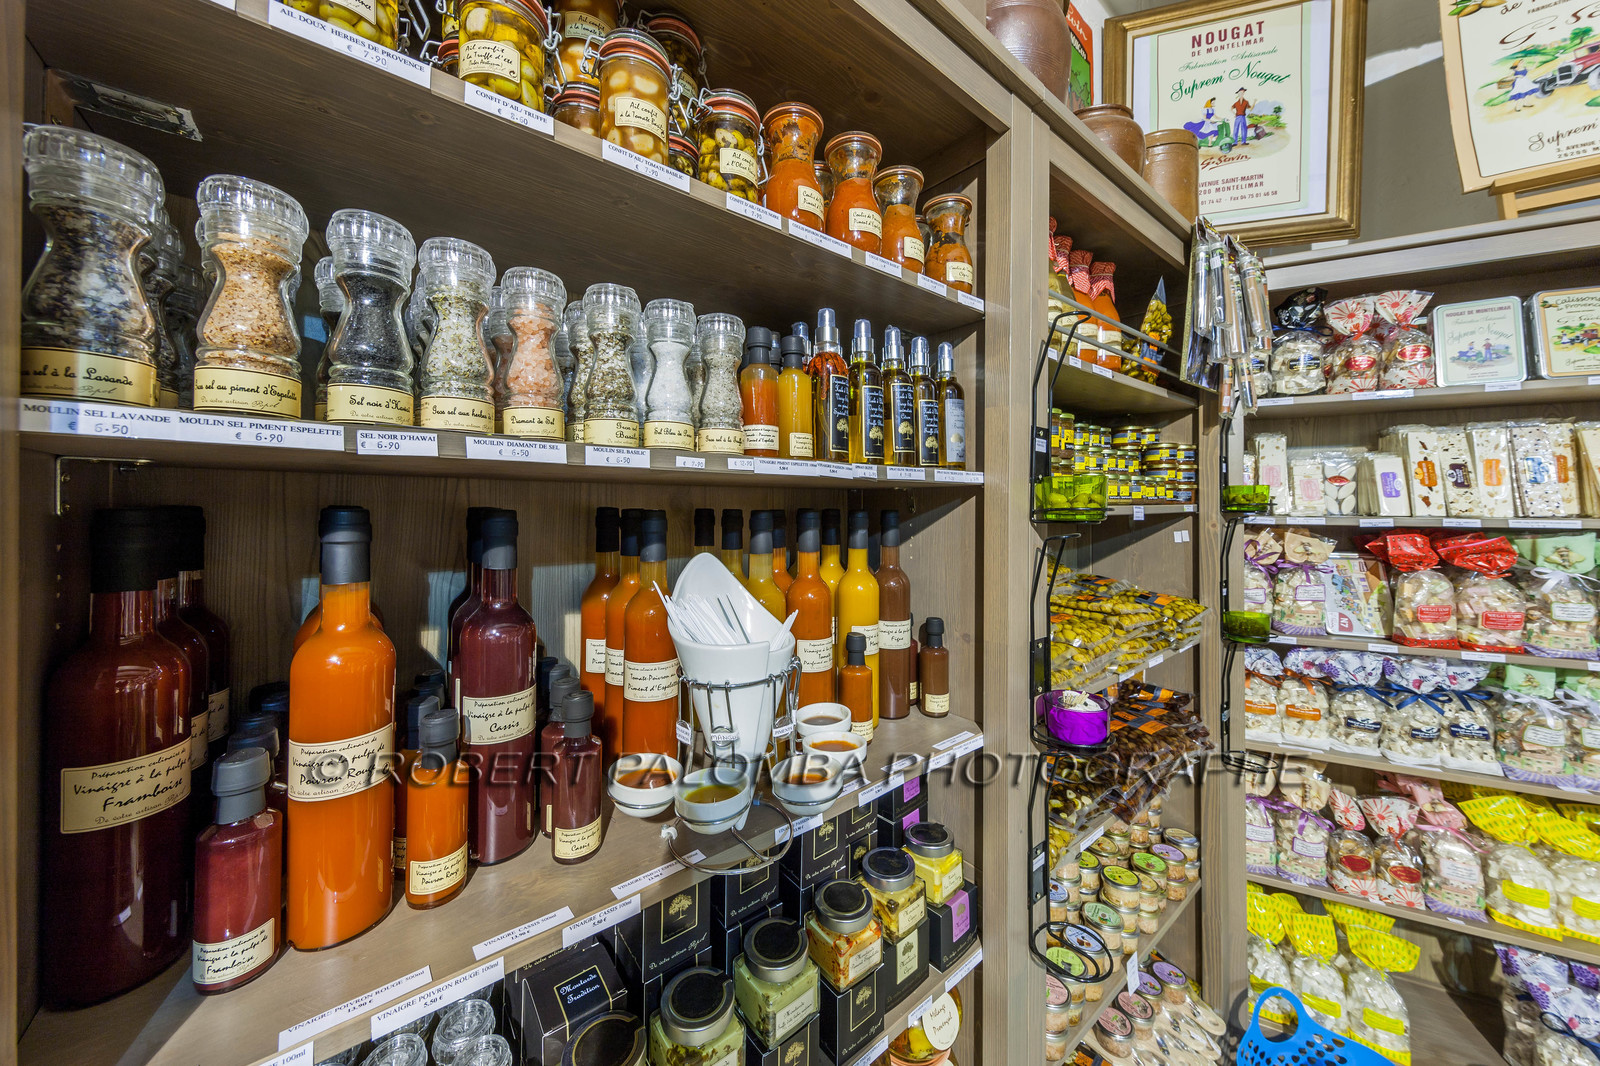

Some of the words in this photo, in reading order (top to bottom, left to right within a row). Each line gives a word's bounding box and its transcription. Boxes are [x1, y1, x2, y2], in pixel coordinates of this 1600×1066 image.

[280, 7, 297, 19] AIL
[299, 15, 327, 31] DOUX
[330, 28, 366, 48] HERBES
[367, 43, 380, 53] DE
[381, 48, 425, 72] PROVENCE
[1191, 20, 1265, 49] NOUGAT
[347, 45, 353, 53] €
[1191, 50, 1202, 58] DE
[1206, 36, 1265, 53] MONTELIMAR
[1178, 58, 1227, 72] Fabrication
[1231, 46, 1279, 61] Artisanale
[1228, 60, 1292, 87] Nougat
[475, 89, 501, 104] CONFIT
[523, 109, 548, 124] TRUFFE
[629, 101, 640, 110] Ail
[641, 107, 658, 118] confit
[631, 111, 651, 123] Tomate
[608, 144, 628, 157] CONFIT
[644, 158, 666, 173] TOMATE
[665, 166, 685, 180] BASILIC
[1215, 181, 1264, 193] MONTELIMAR
[1221, 173, 1264, 185] SAINT-MARTIN
[1445, 310, 1467, 318] NOUGAT
[1475, 305, 1512, 314] MONTELIMAR
[64, 367, 77, 378] la
[82, 367, 134, 386] Lavande
[228, 384, 260, 395] piment
[349, 394, 365, 406] Sel
[366, 400, 383, 408] noir
[24, 404, 80, 416] MOULIN
[84, 409, 108, 418] SEL
[111, 411, 171, 423] LAVANDE
[447, 406, 457, 416] sel
[68, 421, 77, 431] €
[178, 416, 225, 428] MOULIN
[227, 421, 247, 429] SEL
[249, 422, 288, 433] PIMENT
[290, 426, 343, 437] ESPELETTE
[235, 432, 242, 440] €
[255, 433, 284, 443] 6.90
[377, 433, 398, 441] NOIR
[400, 434, 436, 442] D'HAWAI
[377, 440, 400, 450] 6.90
[506, 441, 538, 449] DIAMANT
[1339, 617, 1348, 628] N7
[627, 682, 649, 692] Piment
[467, 709, 496, 722] Vinaigre
[497, 710, 503, 718] à
[505, 707, 514, 716] la
[515, 703, 530, 716] pulpe
[473, 700, 506, 709] Préparation
[489, 721, 520, 733] Cassis
[292, 756, 324, 771] Vinaigre
[351, 748, 376, 763] pulpe
[377, 743, 385, 753] de
[300, 748, 337, 757] Préparation
[338, 740, 370, 752] culinaire
[90, 763, 146, 781] Préparation
[147, 751, 181, 768] culinaire
[73, 779, 131, 796] Vinaigre
[135, 774, 145, 783] à
[149, 769, 163, 780] la
[165, 758, 188, 777] pulpe
[299, 773, 343, 786] Poivron
[102, 777, 184, 812] Framboise
[571, 843, 590, 852] Cassis
[421, 876, 445, 886] Poivron
[445, 868, 460, 879] Rouge
[617, 876, 642, 891] VINAIGRE
[569, 916, 597, 932] VINAIGRE
[597, 905, 618, 920] CASSIS
[618, 898, 633, 910] 100ml
[484, 931, 516, 948] VINAIGRE
[518, 920, 541, 934] CASSIS
[231, 950, 239, 958] la
[206, 955, 254, 975] Framboise
[377, 998, 417, 1022] VINAIGRE
[418, 981, 454, 1003] POIVRON
[454, 969, 480, 988] ROUGE
[481, 961, 499, 974] 100ml
[559, 972, 598, 996] Moutarde
[288, 1010, 333, 1033] VINAIGRE
[334, 991, 374, 1013] POIVRON
[375, 979, 404, 996] ROUGE
[405, 969, 425, 982] 500ml
[566, 983, 600, 1005] Tradition
[346, 1001, 368, 1014] 13.90
[422, 998, 438, 1009] 5.50
[281, 1049, 306, 1066] 100ml
